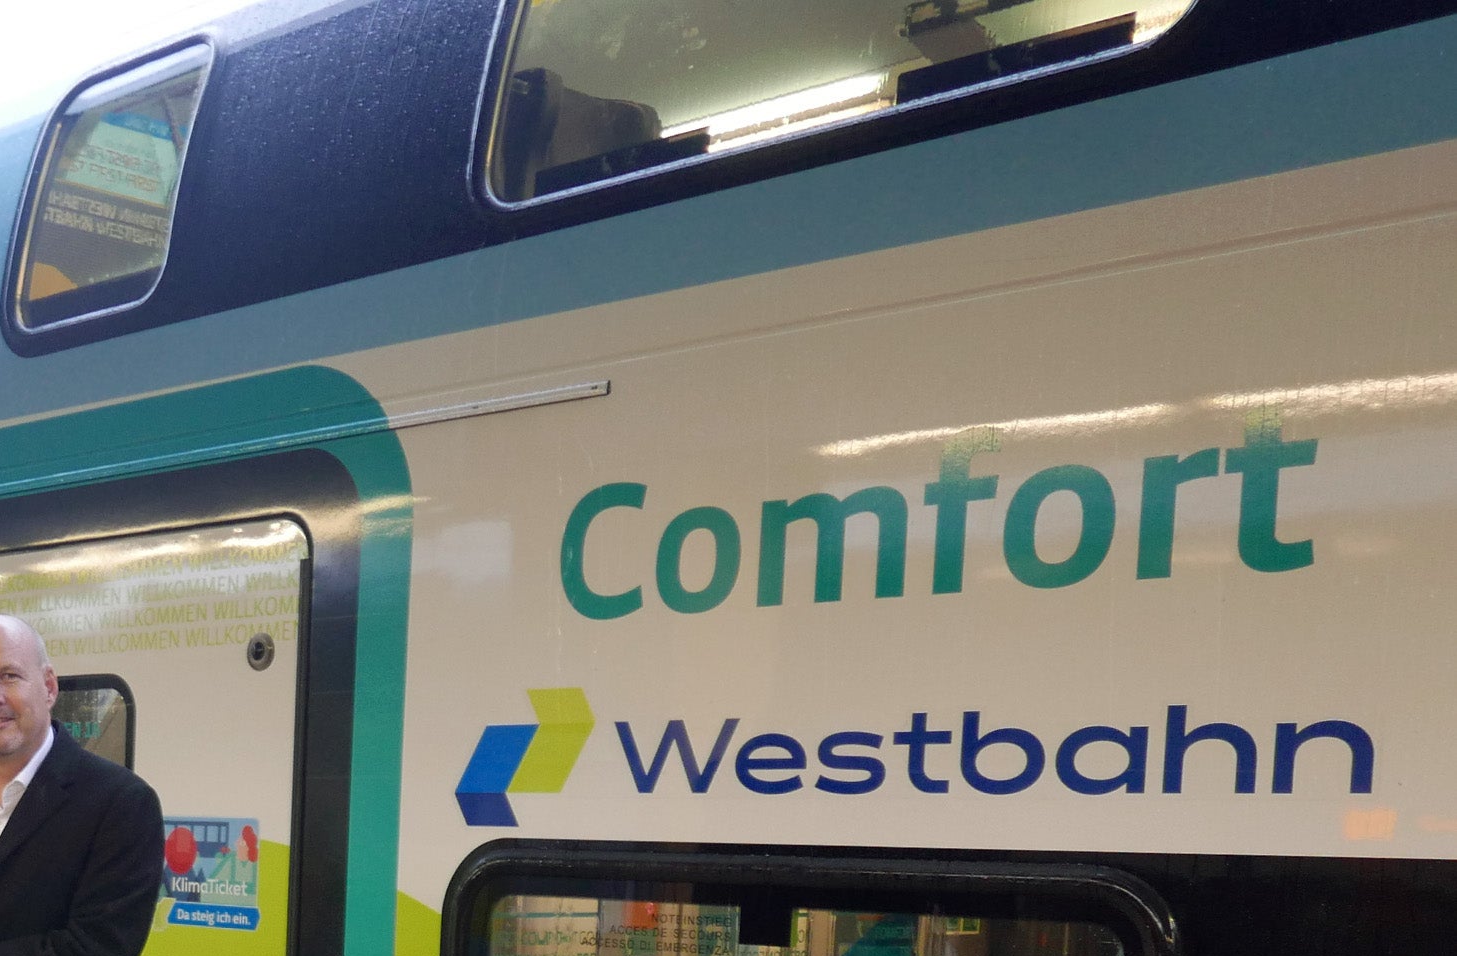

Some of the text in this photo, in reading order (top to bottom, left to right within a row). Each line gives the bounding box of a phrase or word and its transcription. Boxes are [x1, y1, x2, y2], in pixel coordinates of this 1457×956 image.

[559, 408, 1318, 620] Comfort
[127, 574, 239, 605] WILLKOMMEN
[100, 602, 208, 629] WILLKOMMEN
[214, 595, 299, 620] WILLKOM
[75, 630, 179, 656] WILLKOMMEN
[615, 705, 1375, 797] Westbahn
[171, 876, 248, 896] KlimaTicket
[177, 908, 251, 926] Da steig ich ein.
[652, 913, 732, 928] NOTEINSTIEG
[653, 928, 668, 938] DE
[673, 929, 732, 942] SECOURS
[656, 942, 732, 956] EMERGENZA
